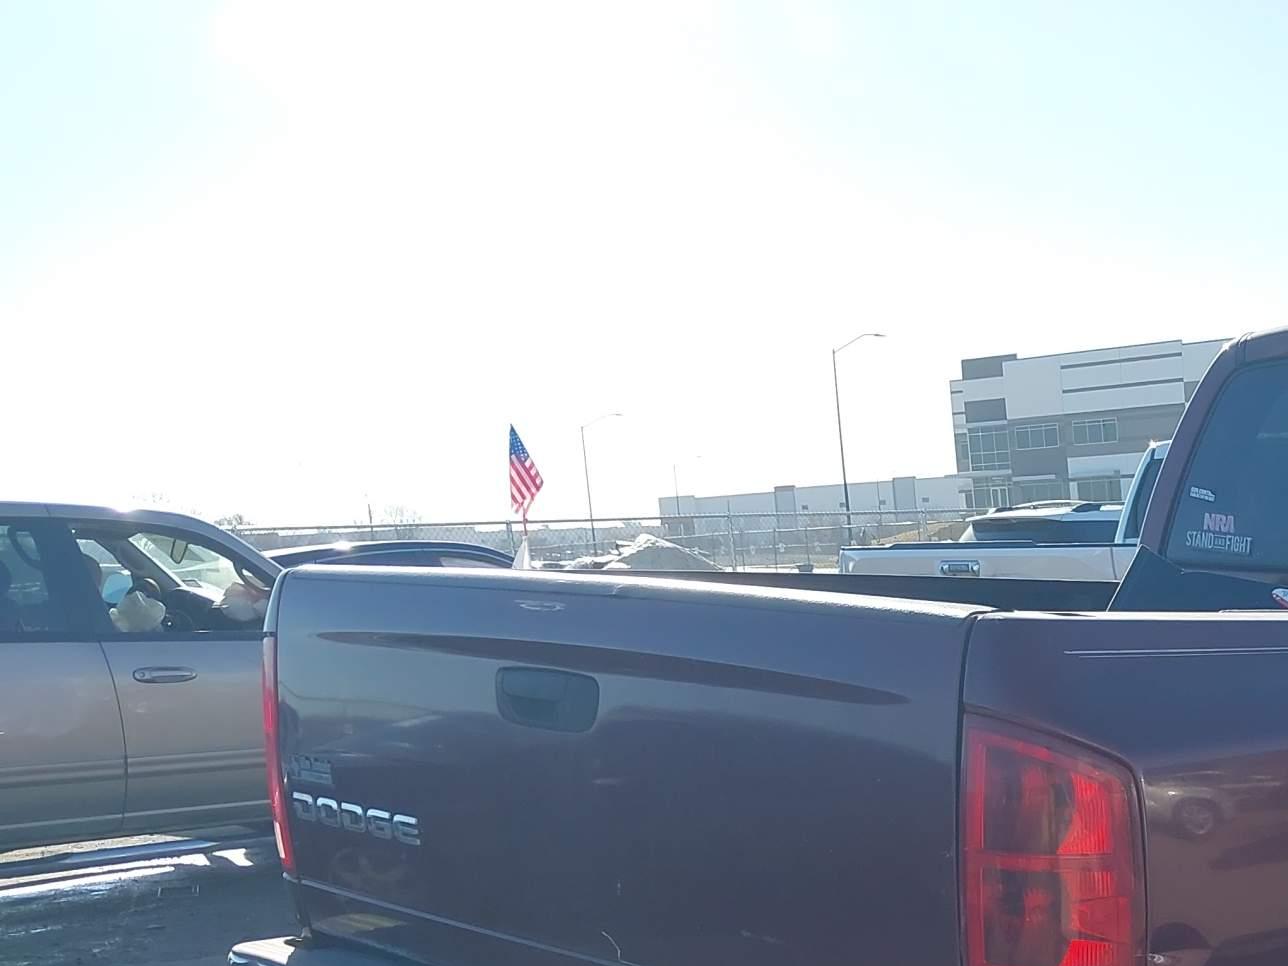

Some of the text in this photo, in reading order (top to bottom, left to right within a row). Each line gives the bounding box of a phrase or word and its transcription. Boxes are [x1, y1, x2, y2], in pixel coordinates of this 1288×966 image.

[1203, 512, 1235, 533] NRA
[1186, 531, 1214, 549] STAND
[1225, 535, 1252, 554] FIGHT
[292, 791, 421, 846] DODGE
